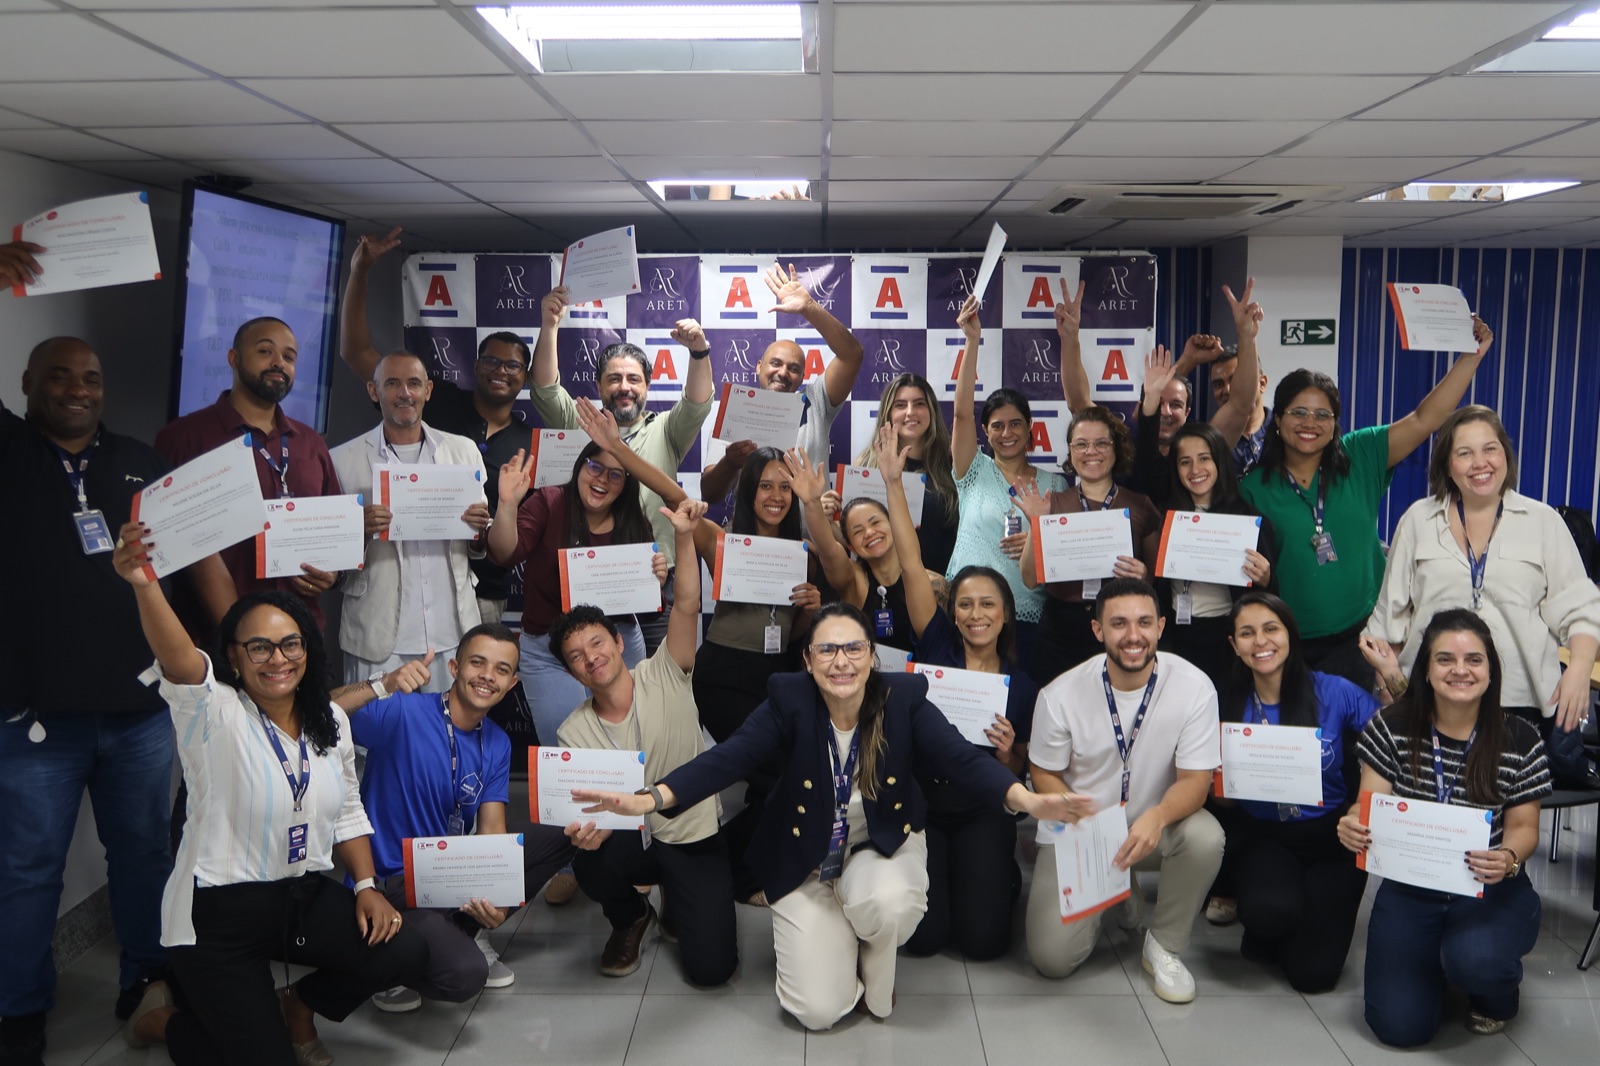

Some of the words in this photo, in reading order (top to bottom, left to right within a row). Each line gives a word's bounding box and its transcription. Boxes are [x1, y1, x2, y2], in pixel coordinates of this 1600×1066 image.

[425, 275, 452, 306] A
[725, 277, 752, 308] A
[876, 278, 903, 308] A
[1026, 276, 1054, 308] A
[496, 299, 534, 308] ARET
[646, 300, 684, 310] ARET
[947, 300, 986, 310] ART
[1098, 300, 1138, 310] ARET
[651, 350, 678, 380] A
[804, 350, 825, 380] A
[1102, 350, 1128, 380] A
[572, 372, 597, 382] ARE
[722, 372, 758, 382] ARET
[1022, 372, 1060, 382] ARET
[1030, 422, 1052, 452] A
[506, 721, 530, 732] ARE
[1392, 818, 1425, 828] CERTIFICADO
[1434, 824, 1468, 834] CONCLUSÃO
